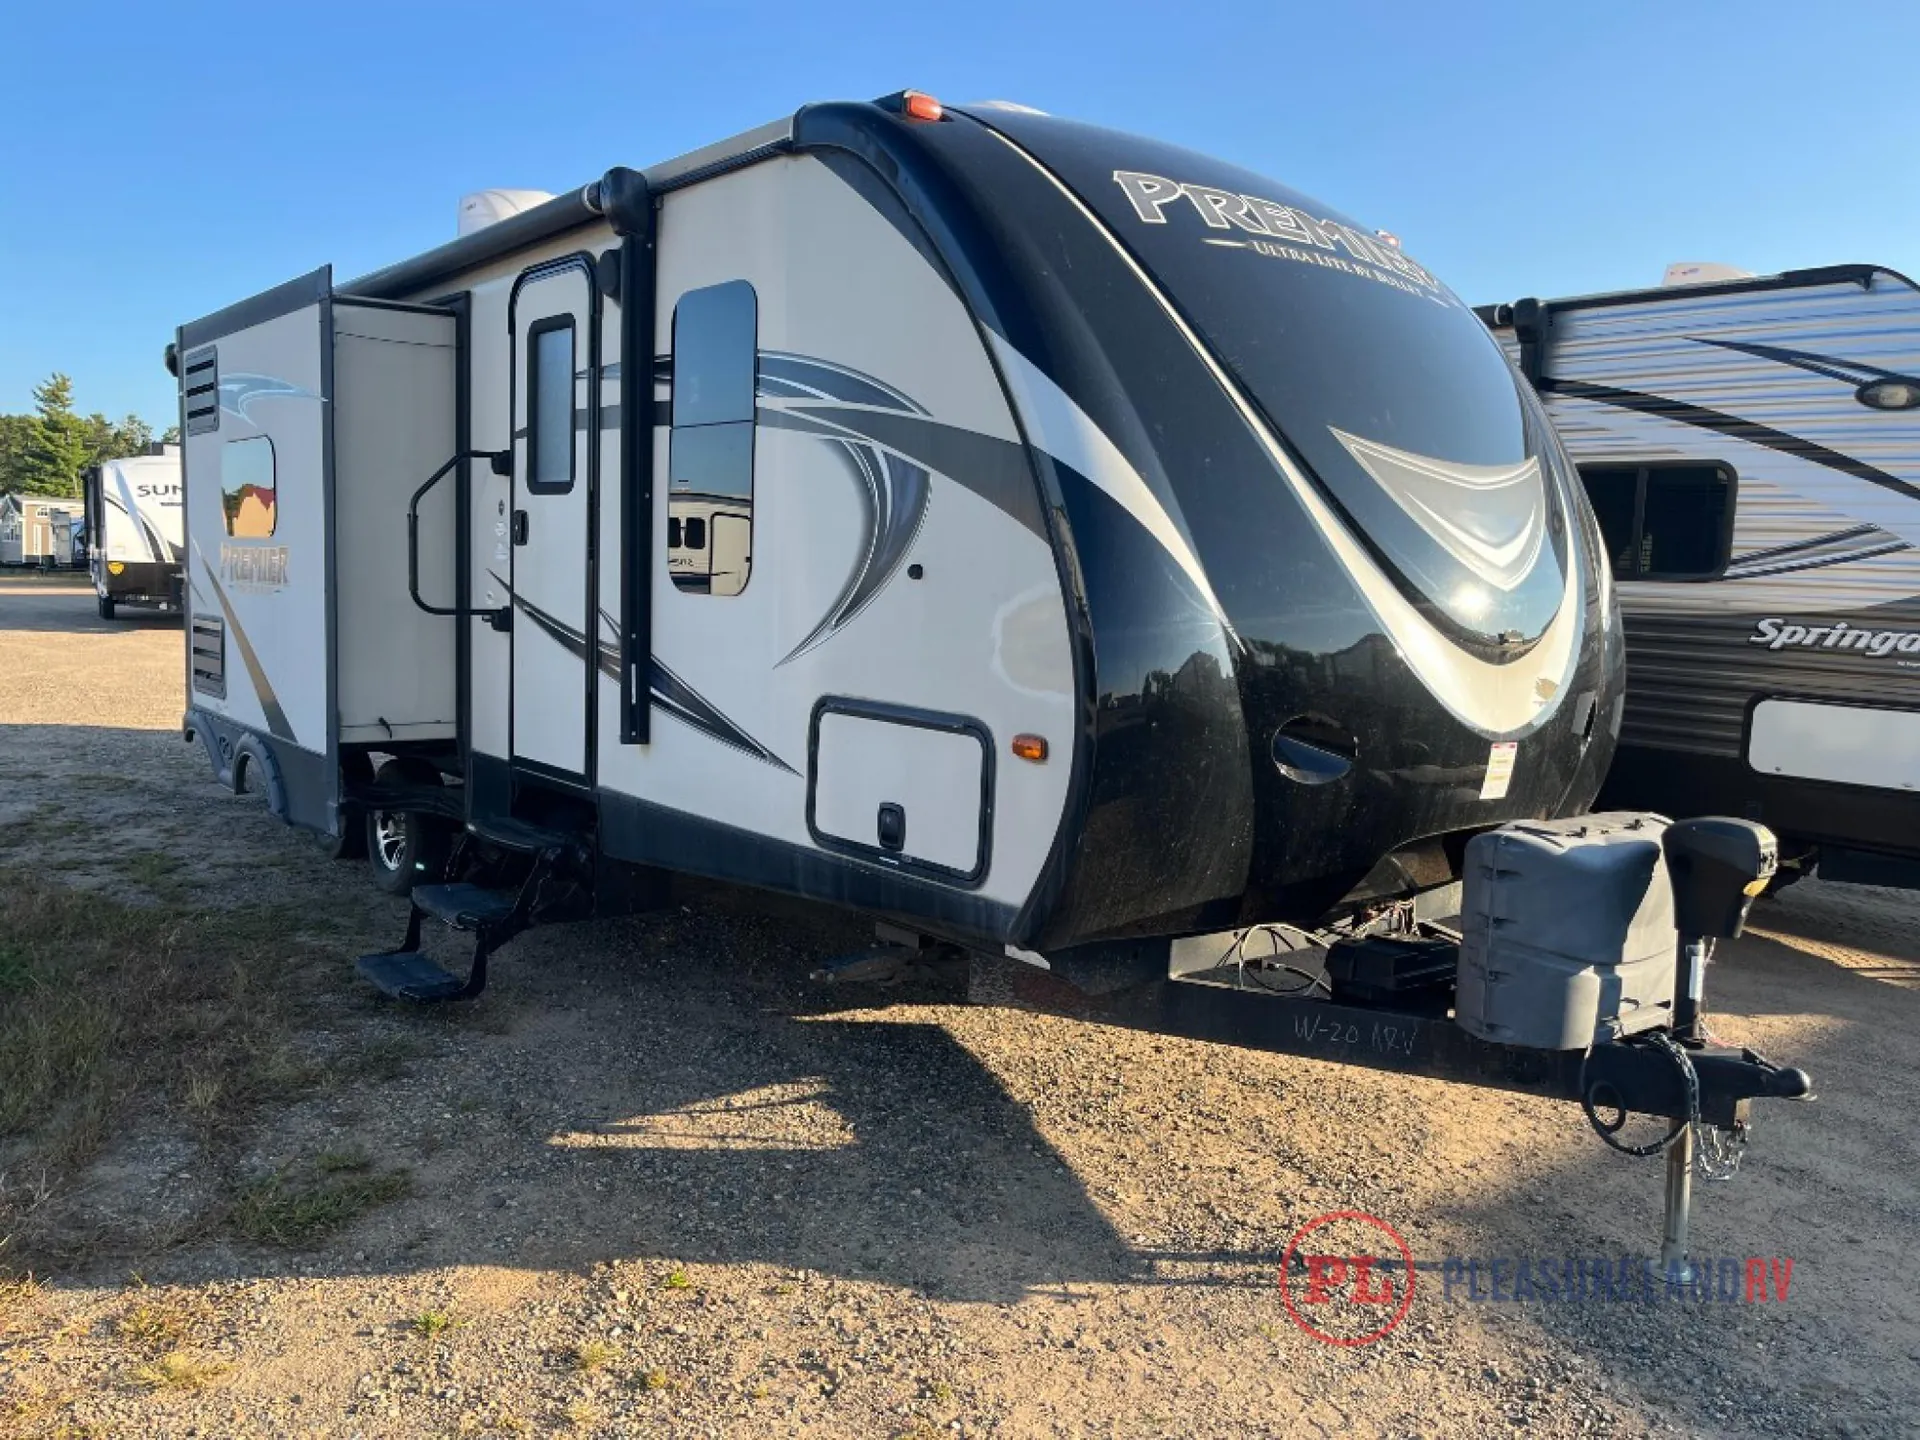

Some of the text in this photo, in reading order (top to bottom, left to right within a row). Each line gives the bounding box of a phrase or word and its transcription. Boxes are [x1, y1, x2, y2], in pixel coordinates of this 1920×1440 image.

[1250, 239, 1313, 264] ULTRA
[220, 541, 290, 587] PREMIER
[1293, 1013, 1359, 1044] W-20
